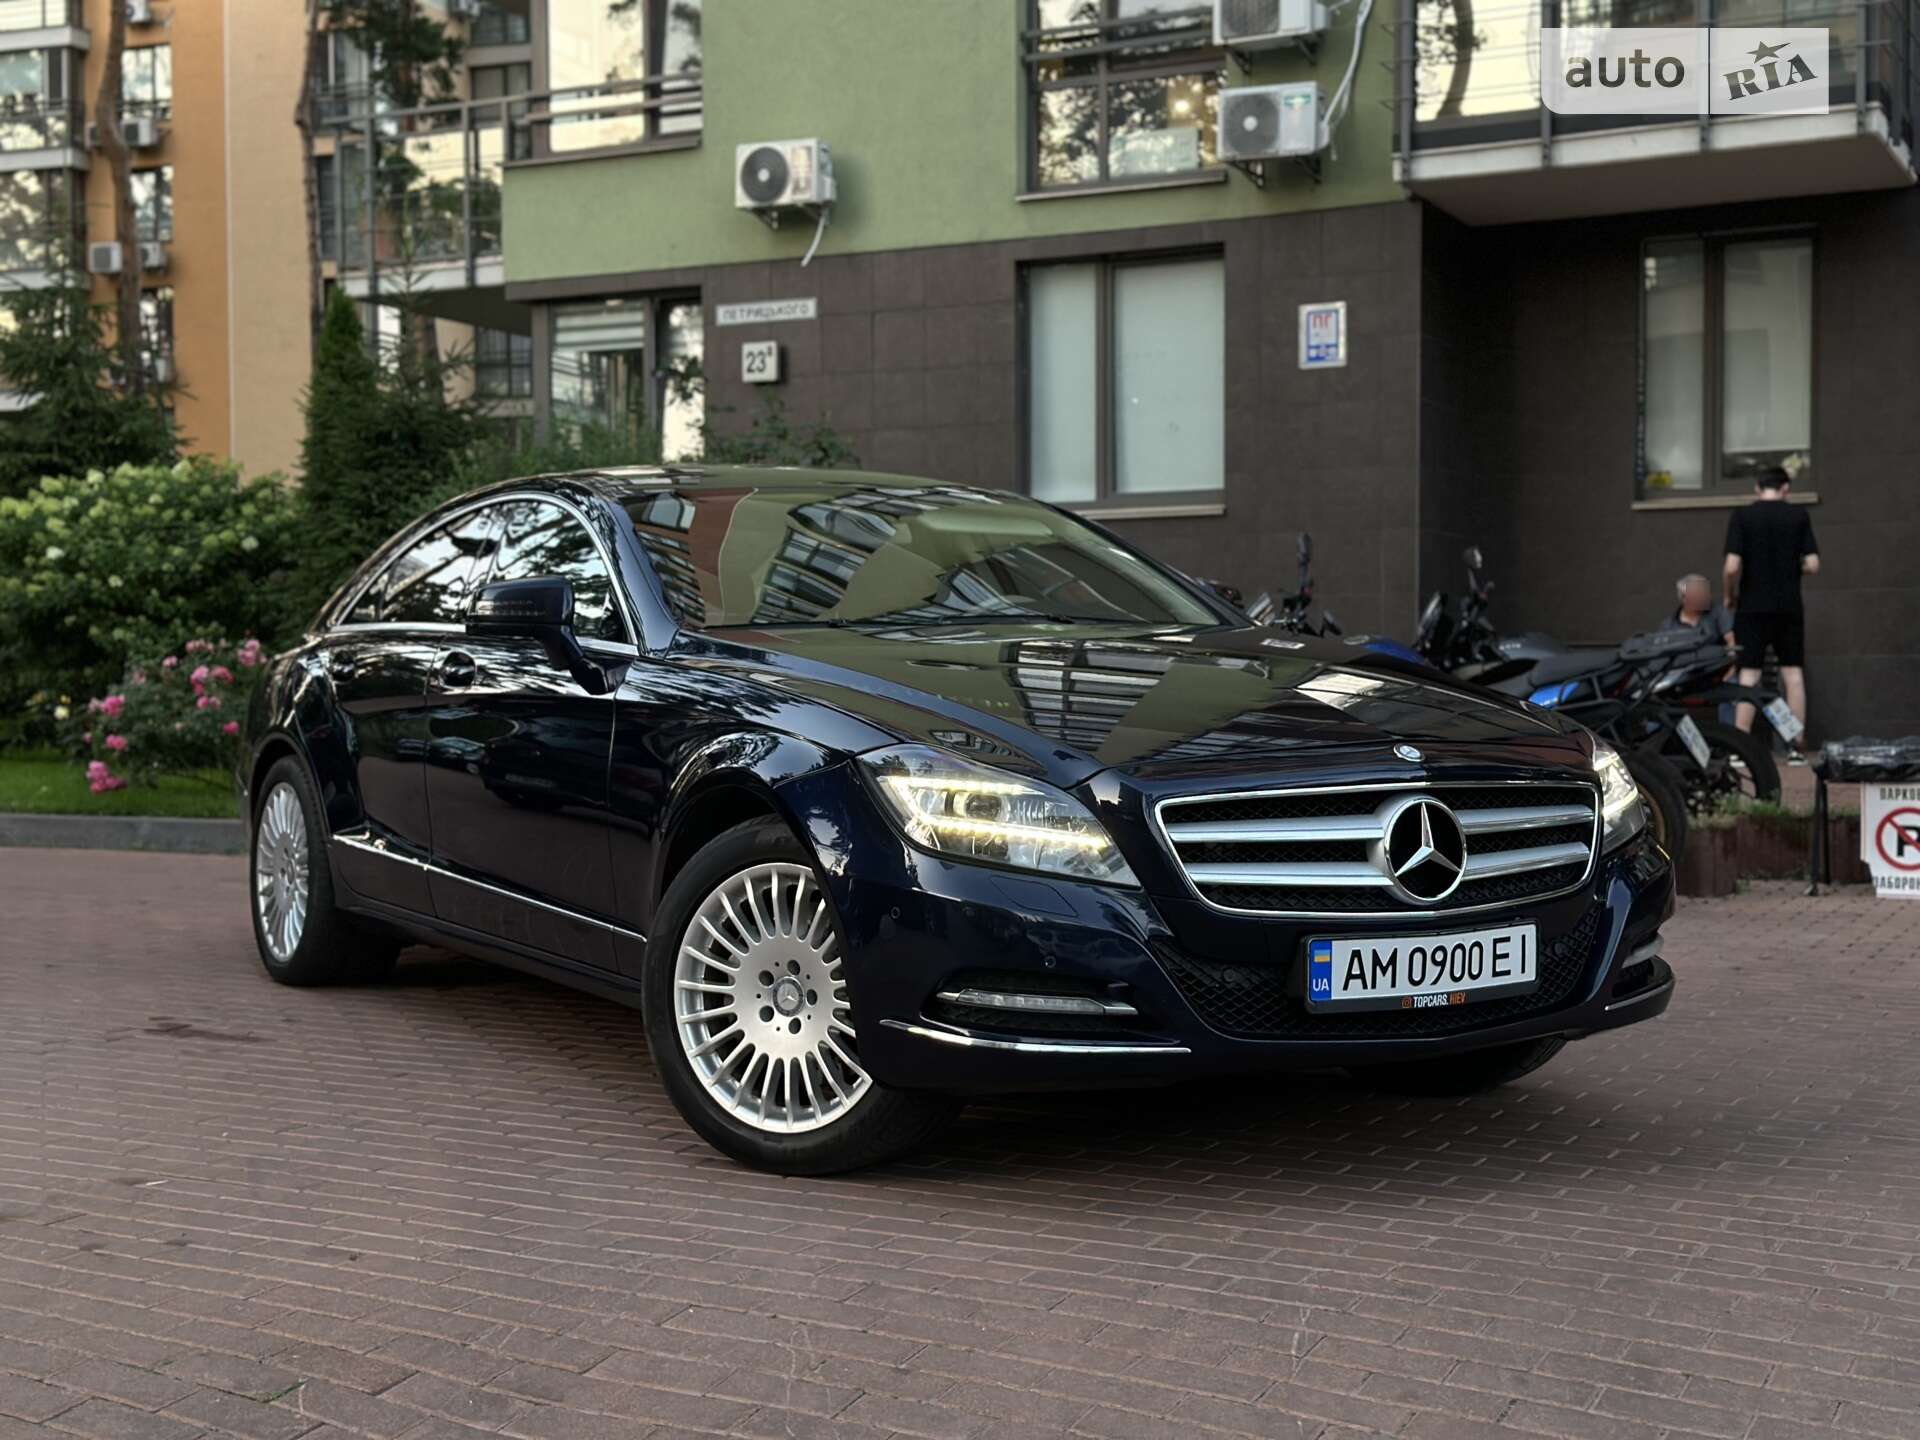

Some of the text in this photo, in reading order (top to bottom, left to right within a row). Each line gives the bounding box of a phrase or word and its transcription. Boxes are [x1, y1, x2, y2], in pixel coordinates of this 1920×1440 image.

[1342, 947, 1398, 991] AM
[1407, 940, 1484, 987] 0900
[1312, 978, 1330, 992] UA
